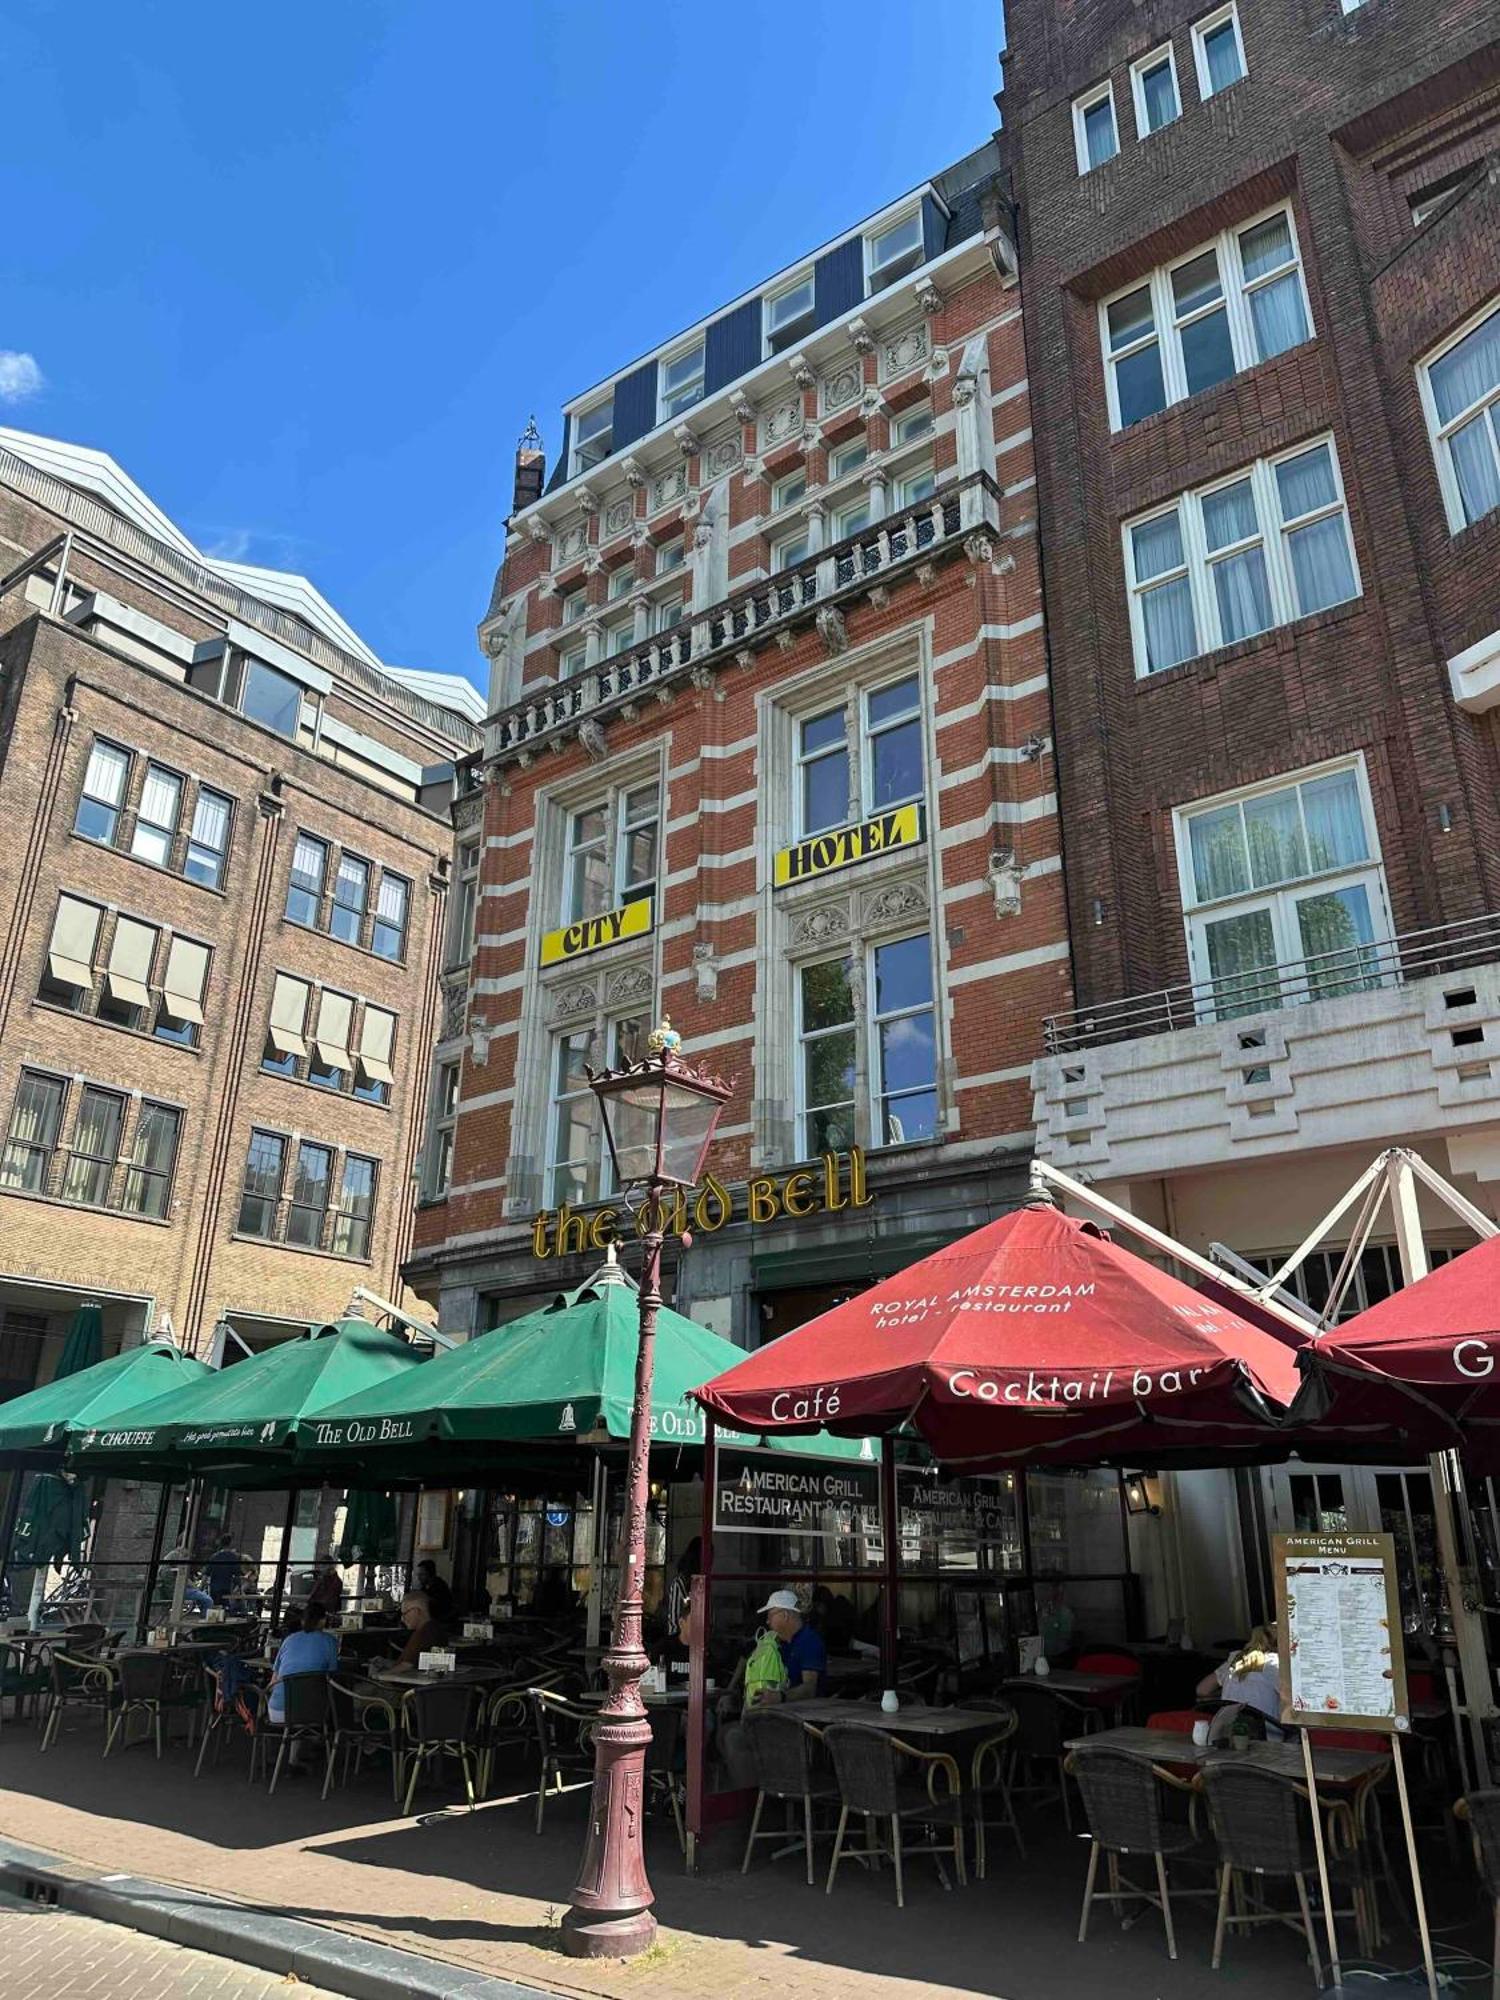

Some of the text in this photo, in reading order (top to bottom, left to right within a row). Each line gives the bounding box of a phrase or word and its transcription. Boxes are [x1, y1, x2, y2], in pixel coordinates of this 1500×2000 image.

[788, 814, 902, 879] HOTEL
[563, 906, 628, 954] CITY
[869, 1282, 1096, 1316] ROYAL AMSTERDAM
[875, 1309, 929, 1329] hotel
[950, 1300, 1072, 1314] restaurant
[948, 1368, 1204, 1402] Cocktail bar
[770, 1386, 842, 1422] Café
[100, 1431, 156, 1446] CHOUFFE
[738, 1466, 863, 1498] AMERICAN GRILL
[720, 1490, 822, 1518] RESTAURANT
[1286, 1536, 1380, 1546] AMERICAN GRILL
[1318, 1545, 1347, 1555] MENU
